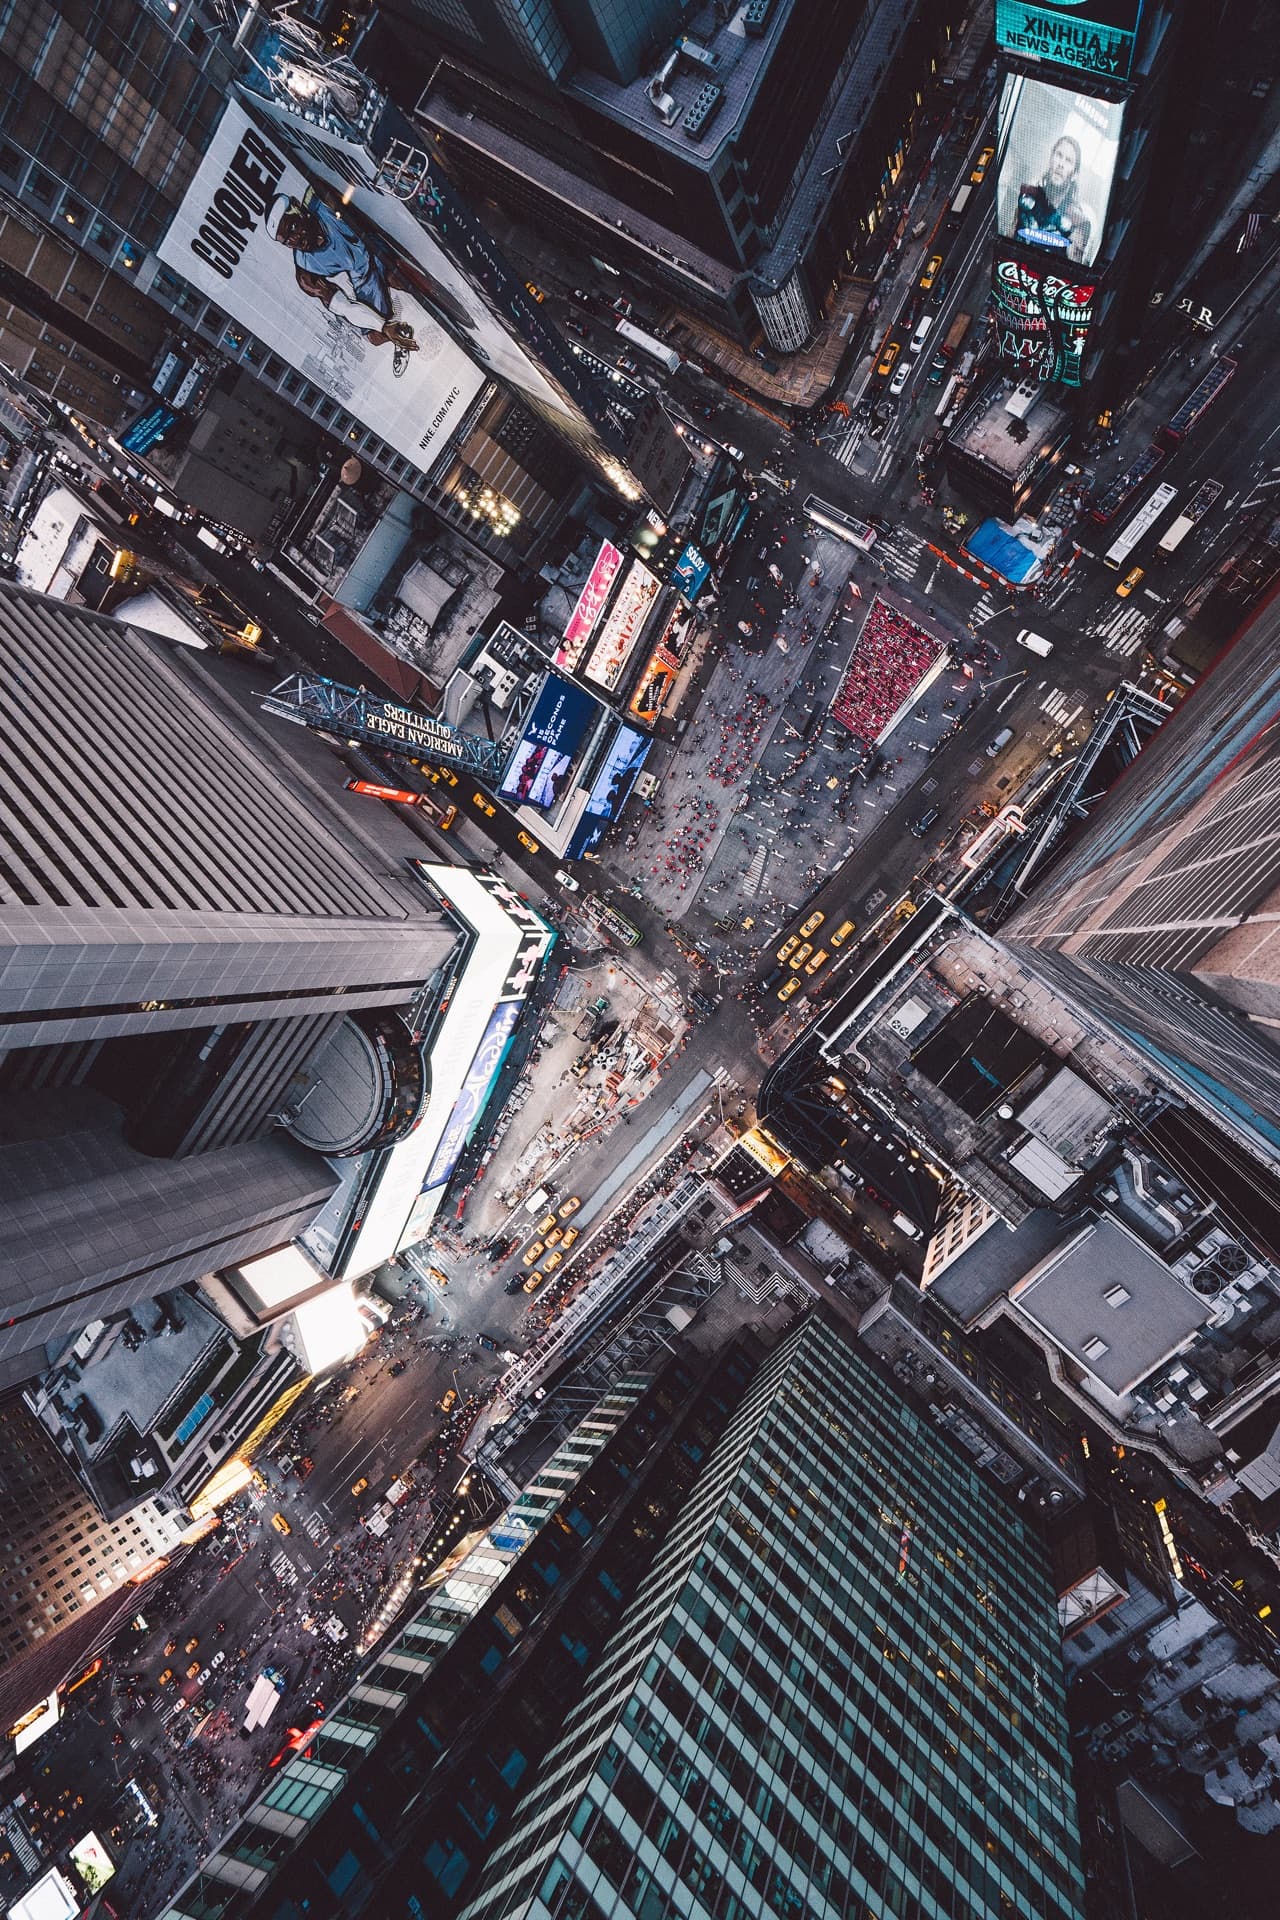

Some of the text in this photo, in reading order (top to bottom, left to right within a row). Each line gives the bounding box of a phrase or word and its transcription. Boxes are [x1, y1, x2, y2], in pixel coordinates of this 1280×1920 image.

[1006, 30, 1118, 73] NEWS AGENCY
[1024, 15, 1102, 52] XINHUA
[191, 128, 286, 280] CONQUER
[1024, 228, 1065, 248] SAMSUNG
[418, 387, 460, 449] NIKE.COM/NYC
[367, 713, 464, 757] AMERICAN EAGLE
[384, 703, 451, 739] OUTFITTERS
[541, 694, 566, 740] SECONDS
[551, 719, 566, 745] FAME
[464, 1006, 518, 1123] Aladdin
